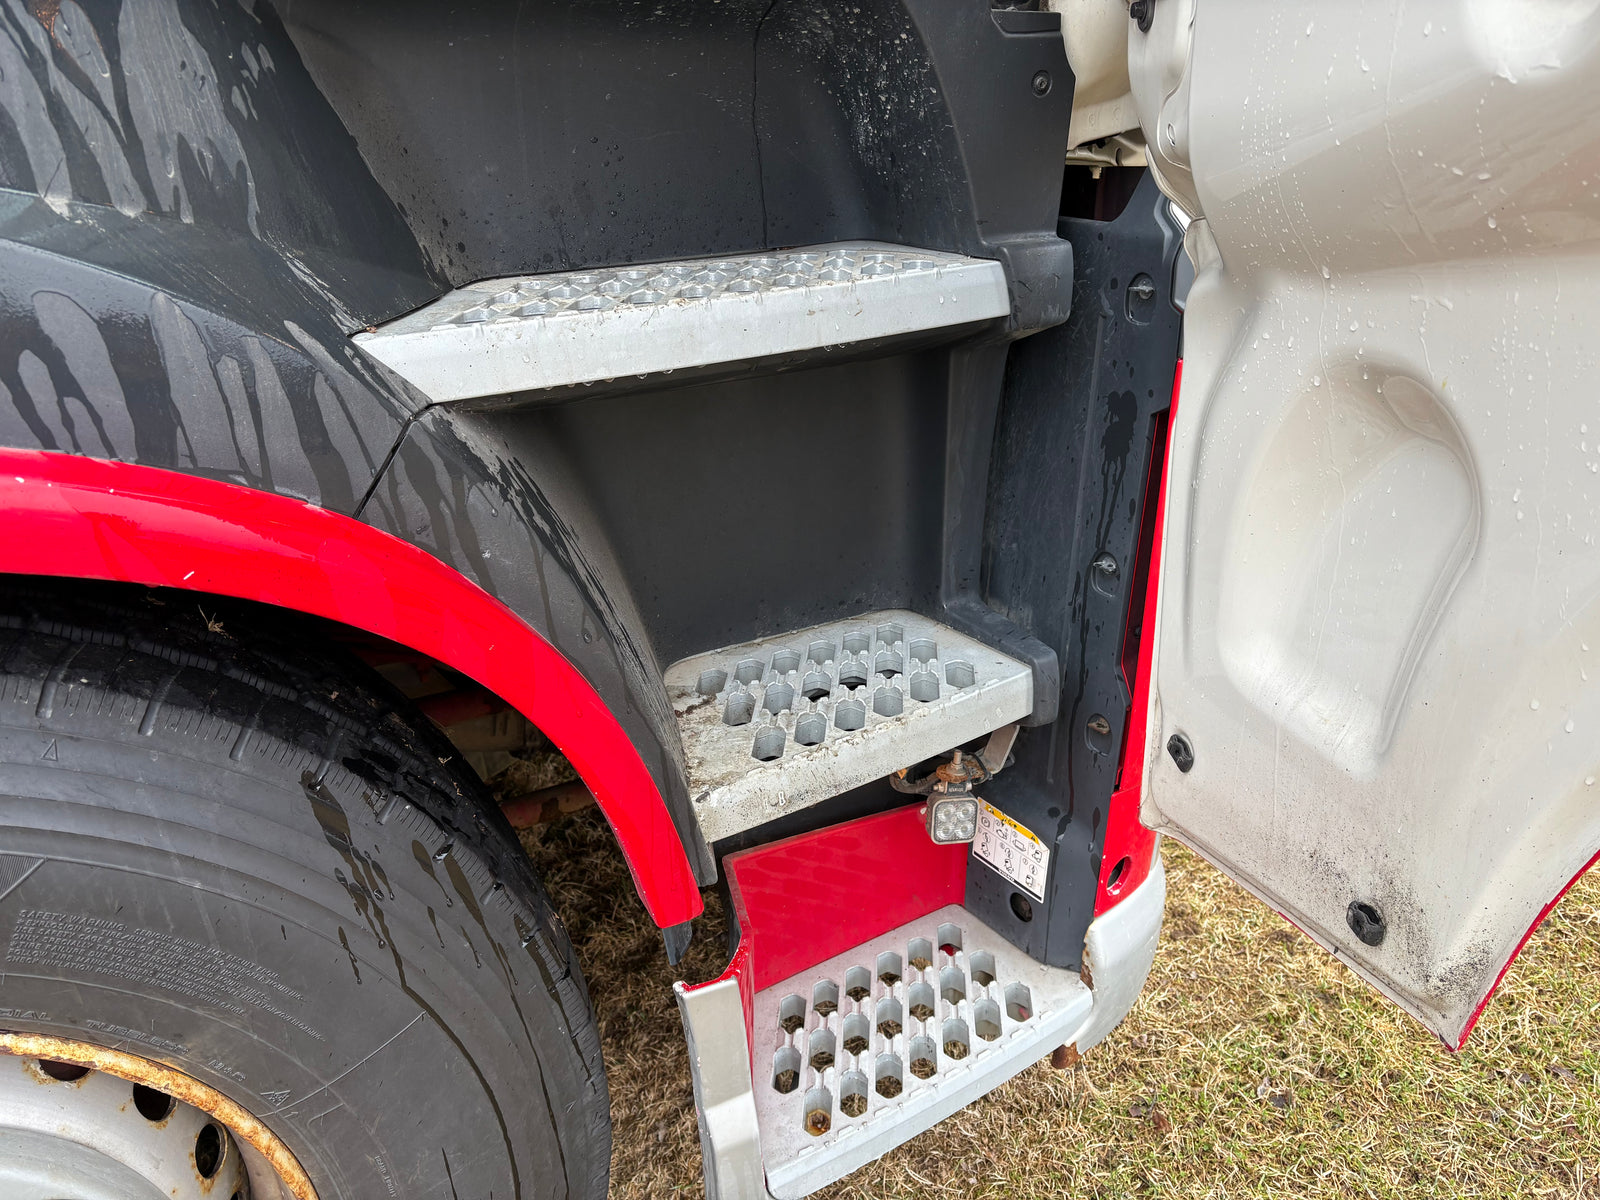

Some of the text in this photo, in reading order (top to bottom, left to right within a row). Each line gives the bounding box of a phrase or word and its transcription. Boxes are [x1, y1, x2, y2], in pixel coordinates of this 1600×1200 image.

[19, 909, 67, 922] SAFETY
[14, 926, 35, 934] USE
[38, 928, 76, 938] SAFETY
[79, 933, 105, 943] CAGE
[84, 927, 98, 935] OF
[12, 933, 39, 942] ONLY
[41, 936, 94, 949] SPECIALLY
[96, 944, 136, 957] TRAINED
[44, 944, 86, 956] FAILURE
[87, 950, 108, 959] DUE
[110, 954, 124, 963] TO
[7, 948, 48, 957] FOLLOW
[51, 952, 73, 961] TIRE
[6, 955, 39, 964] CHECK
[42, 959, 94, 971] INFLATION
[95, 967, 143, 982] PRESSURE
